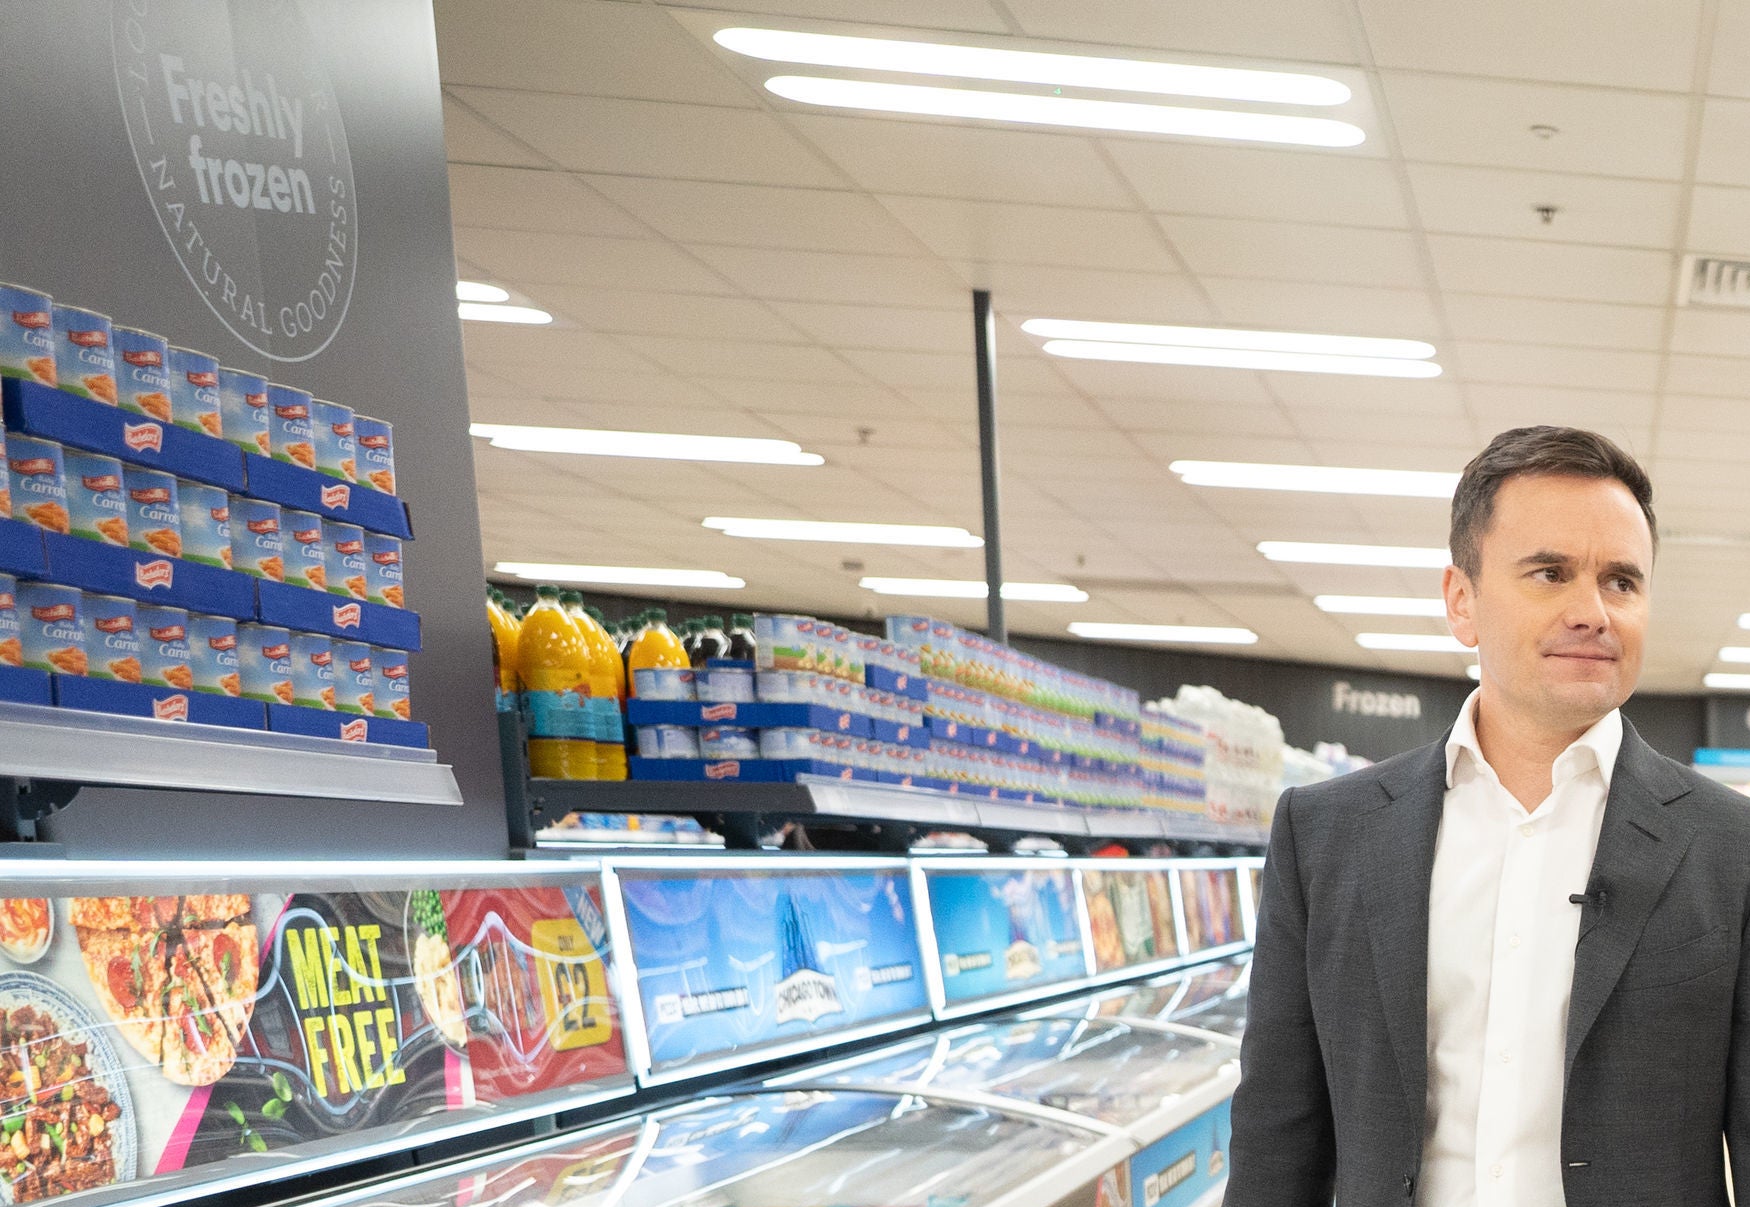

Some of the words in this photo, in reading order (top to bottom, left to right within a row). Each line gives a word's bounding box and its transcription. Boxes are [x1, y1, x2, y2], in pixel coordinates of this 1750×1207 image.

[160, 53, 302, 158] Freshly
[189, 135, 315, 214] frozen
[149, 157, 274, 335] NATURAL
[280, 176, 348, 338] GOODNESS
[1332, 681, 1421, 719] Frozen
[286, 923, 396, 1010] MEAT
[556, 963, 597, 1031] £2
[302, 1008, 408, 1098] FREE
